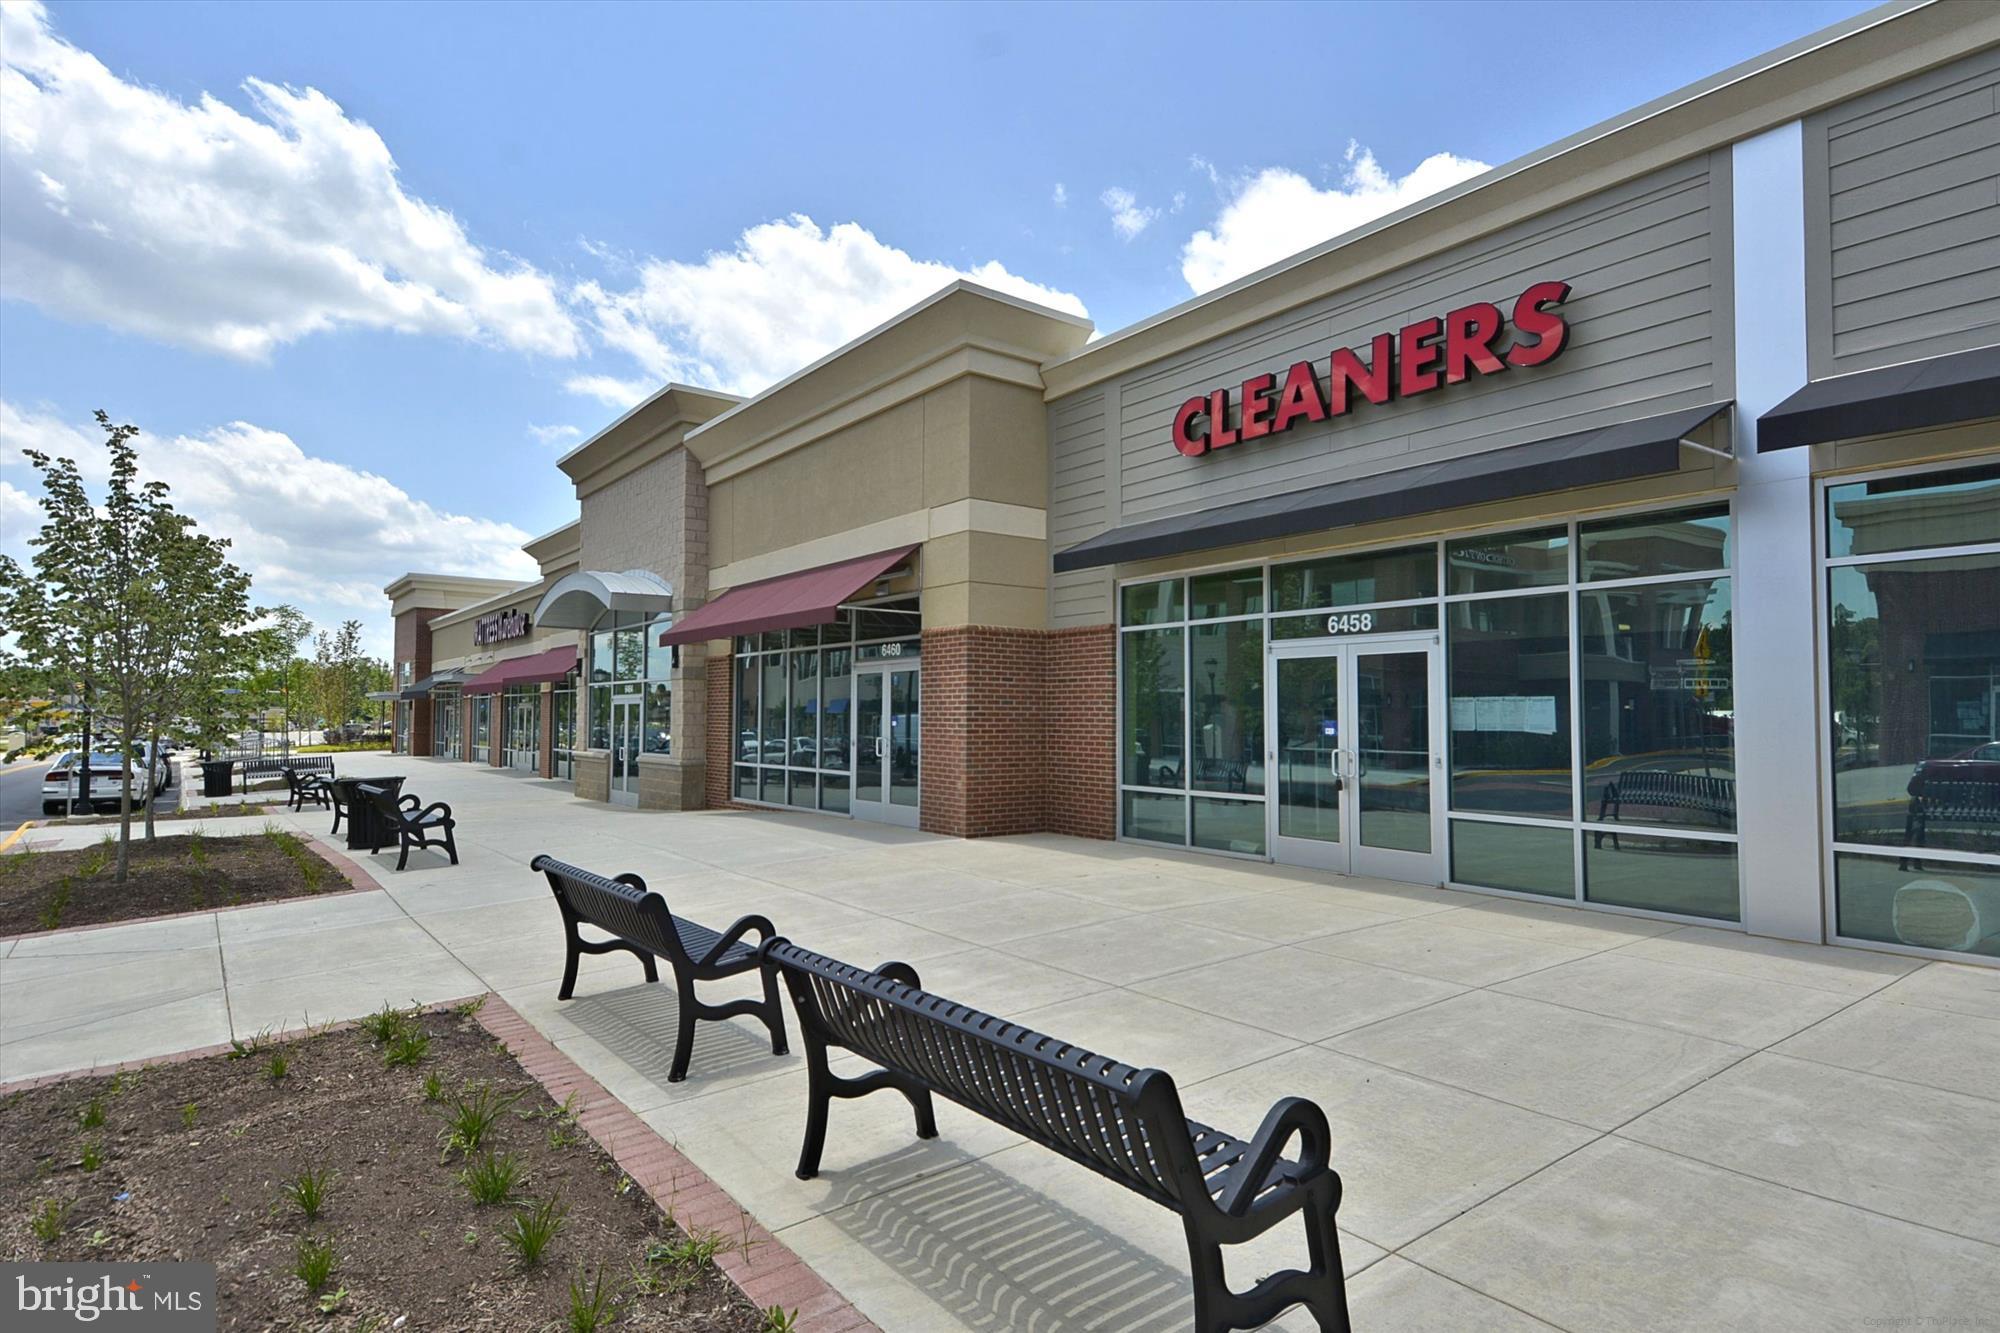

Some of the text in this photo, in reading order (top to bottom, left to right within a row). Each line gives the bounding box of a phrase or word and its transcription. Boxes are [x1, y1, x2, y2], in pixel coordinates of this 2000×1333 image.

[1172, 281, 1572, 457] CLEANERS
[1327, 613, 1372, 634] 6458
[881, 643, 901, 657] 6460
